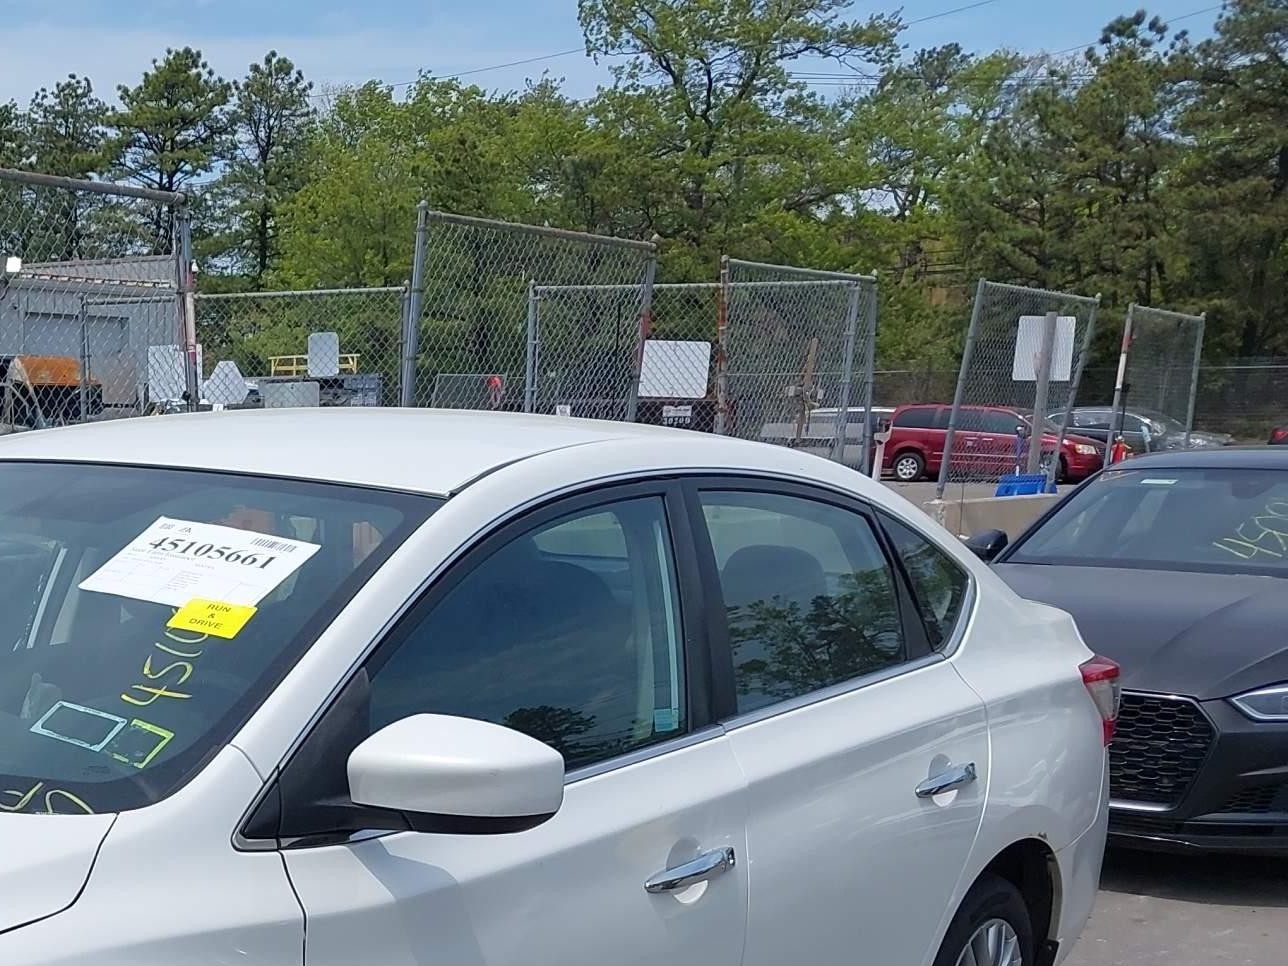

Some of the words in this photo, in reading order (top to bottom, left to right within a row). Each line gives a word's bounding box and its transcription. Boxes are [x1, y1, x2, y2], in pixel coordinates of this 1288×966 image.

[149, 536, 276, 569] 45105661
[206, 603, 232, 613] RUN
[188, 617, 223, 630] DRIVE
